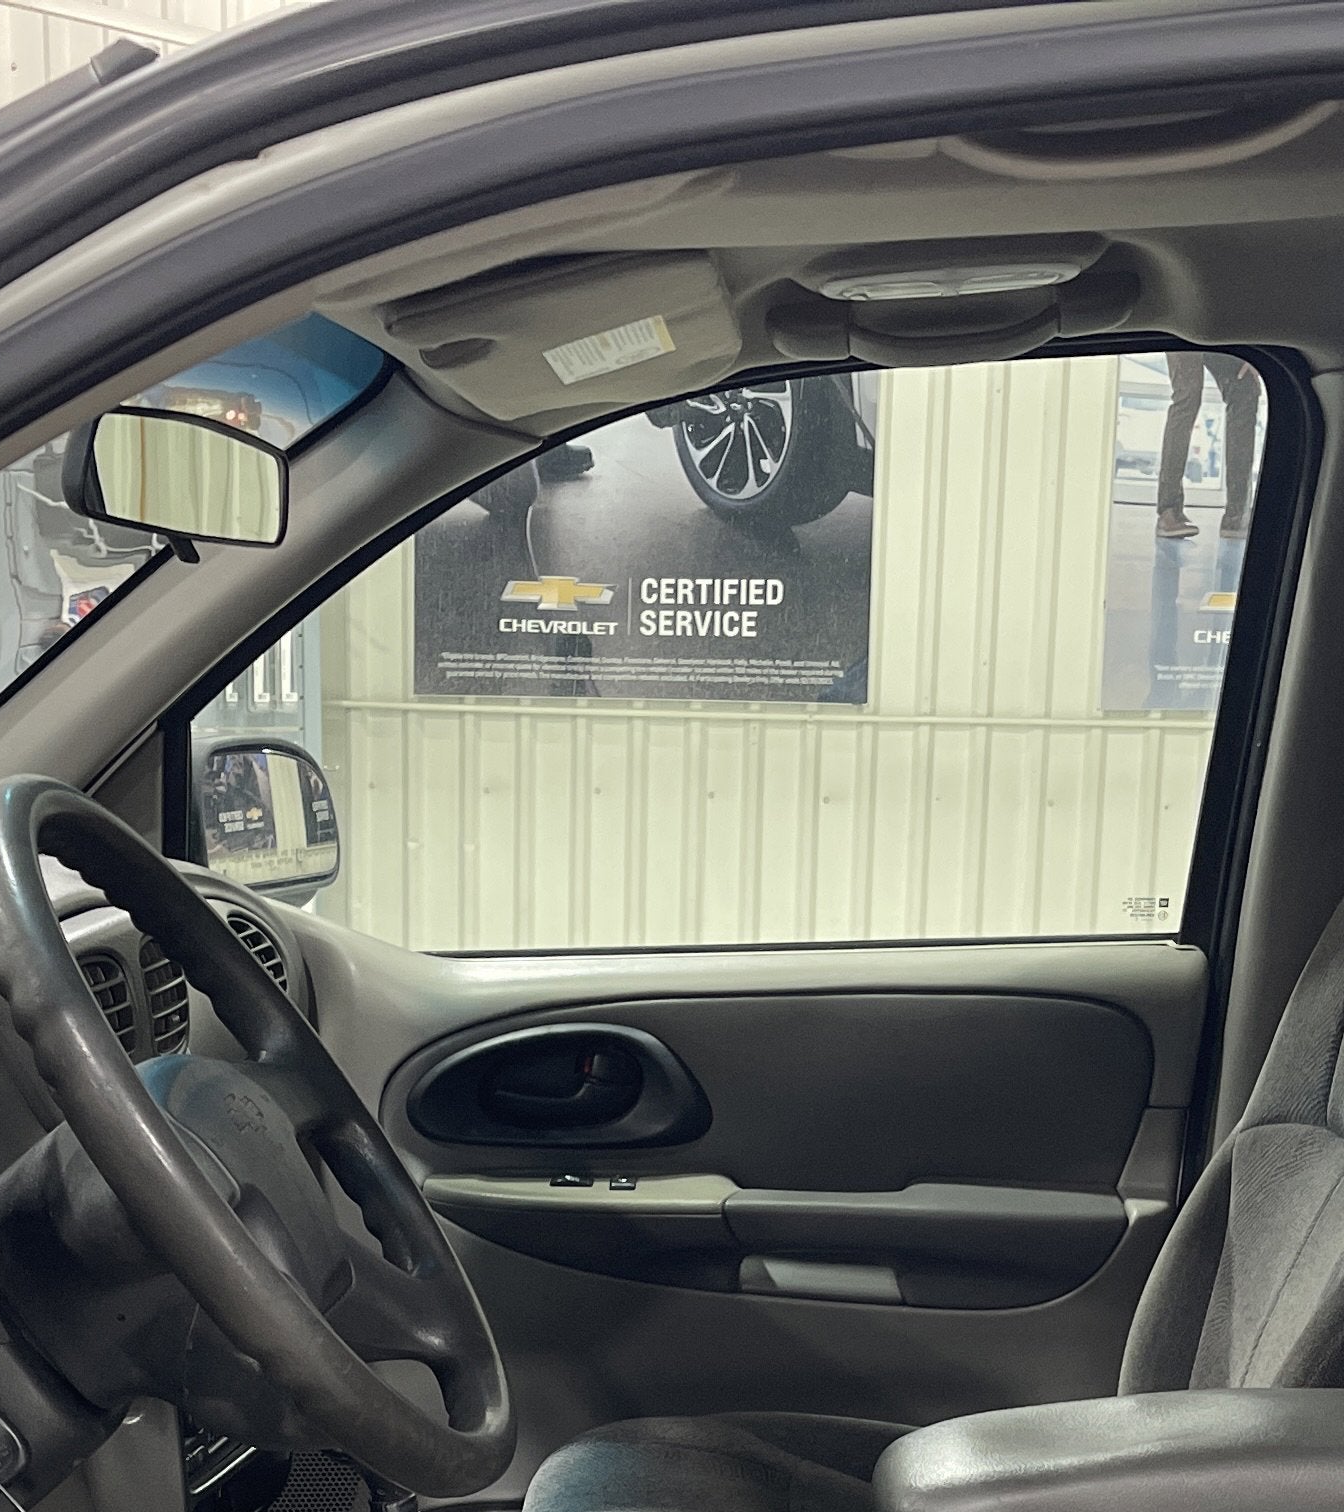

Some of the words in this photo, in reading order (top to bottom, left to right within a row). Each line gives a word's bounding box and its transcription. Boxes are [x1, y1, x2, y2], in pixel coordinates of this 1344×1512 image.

[640, 577, 785, 605] CERTIFIED
[498, 618, 619, 635] CHEVROLET
[639, 610, 758, 637] SERVICE
[1193, 630, 1232, 644] CHE
